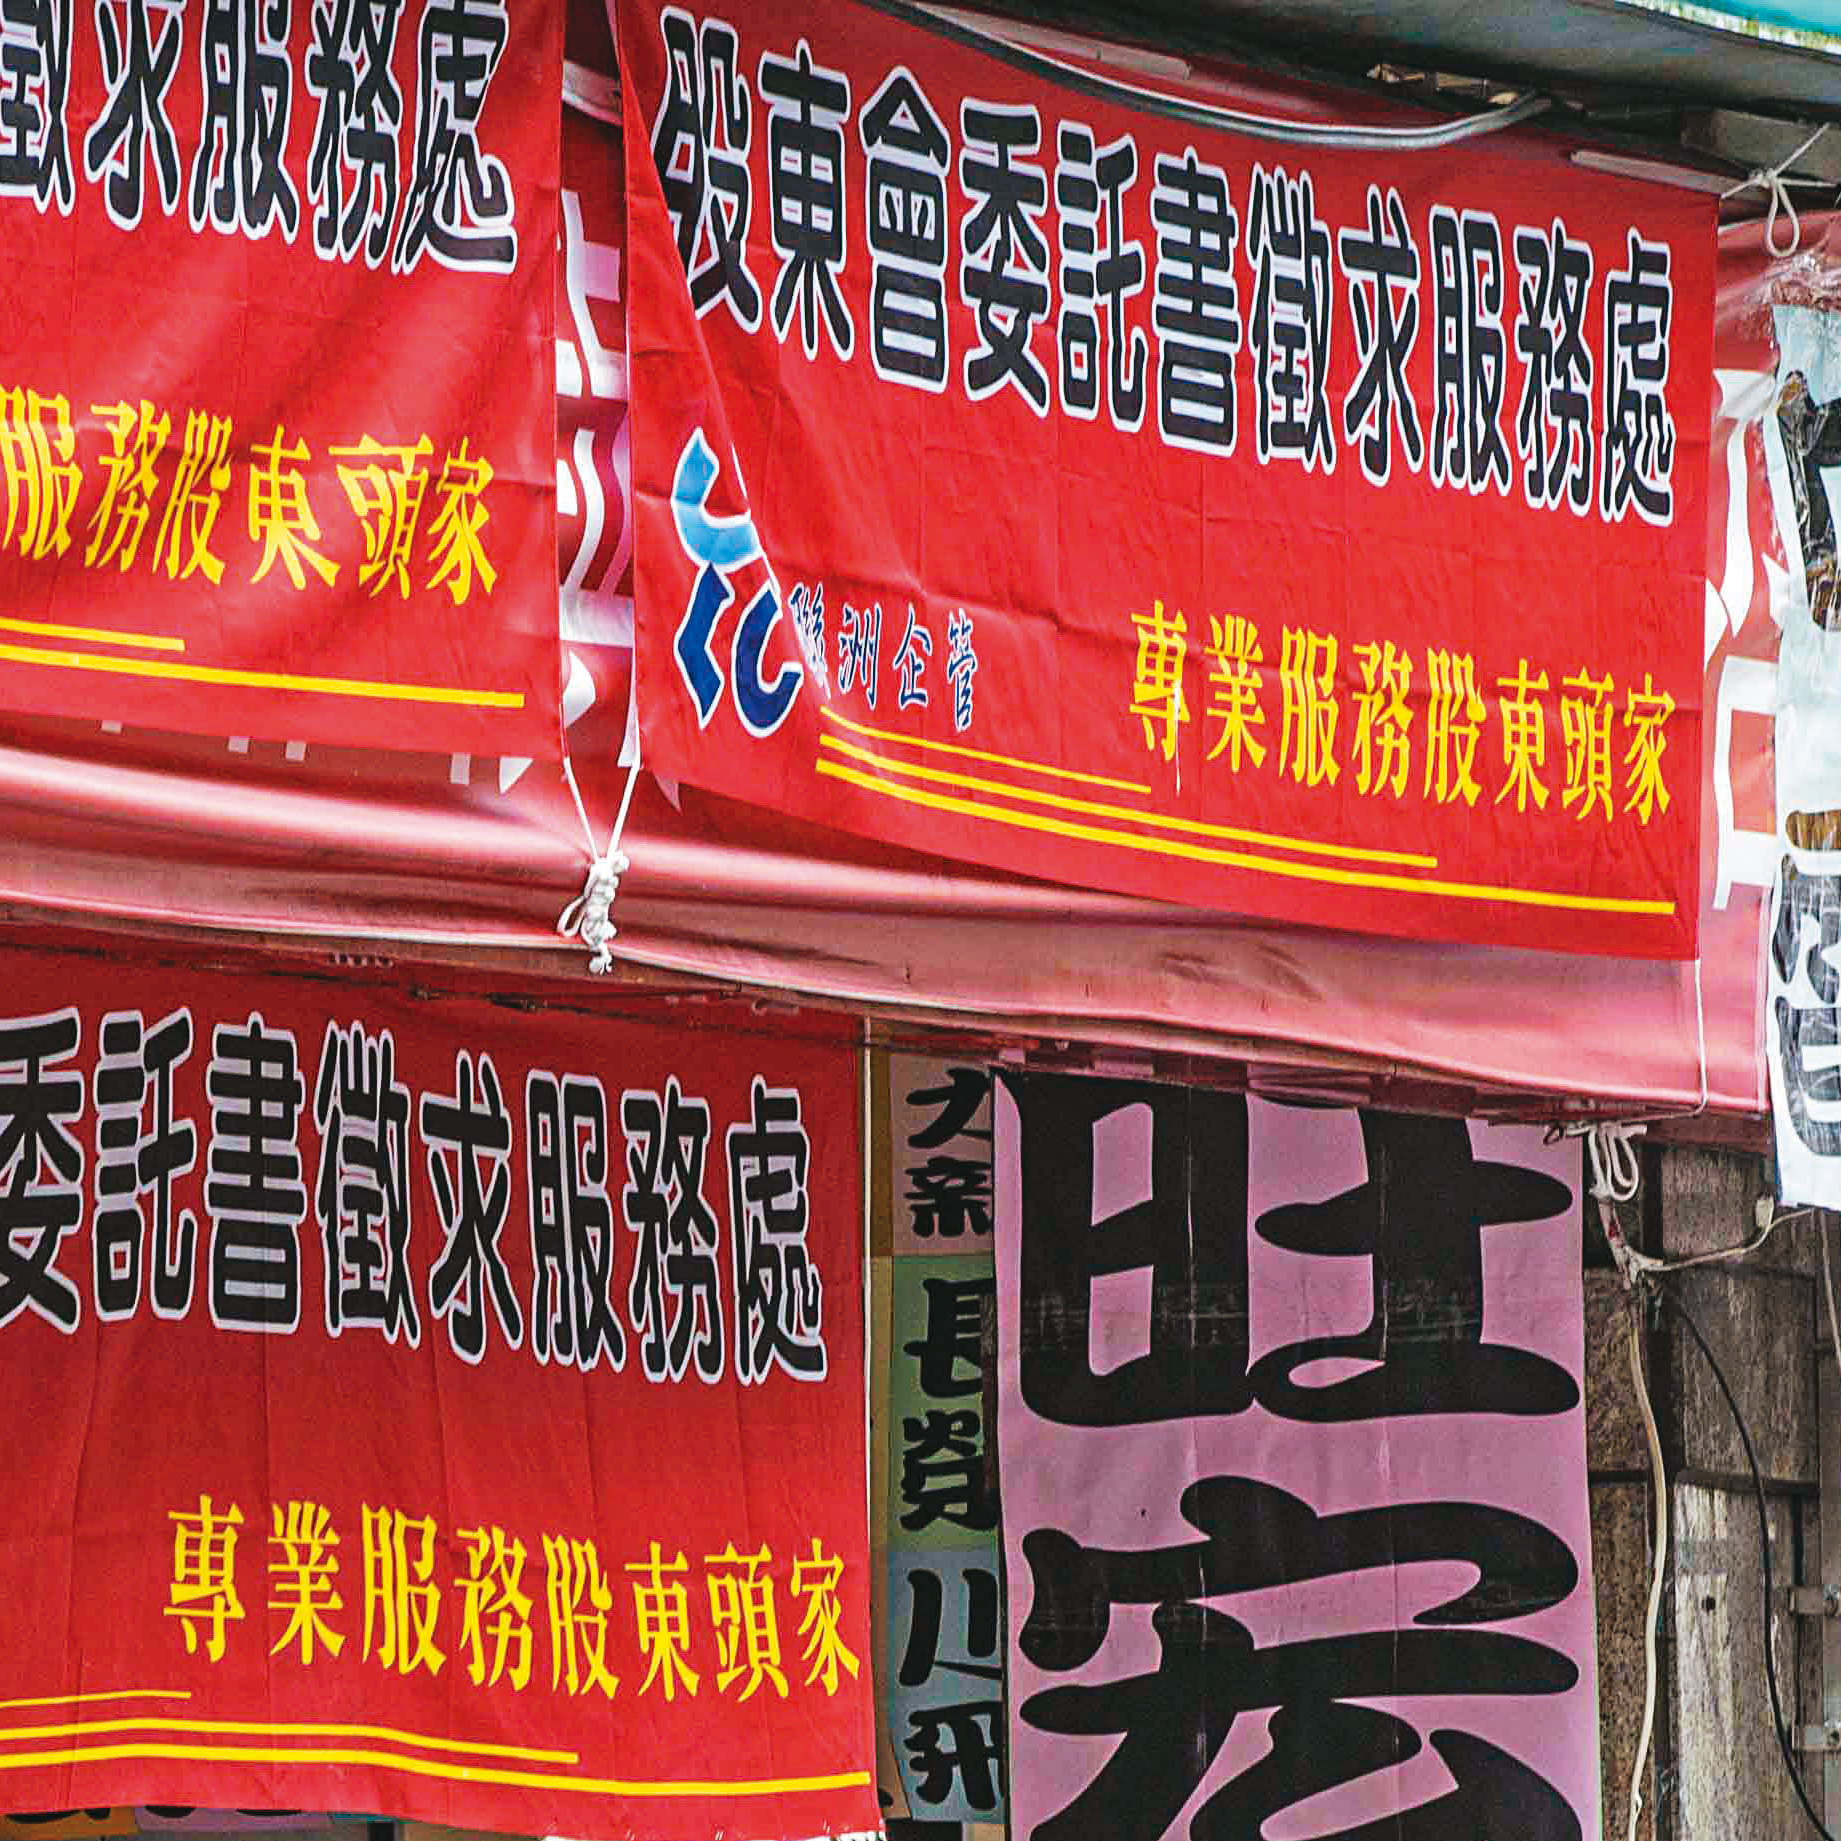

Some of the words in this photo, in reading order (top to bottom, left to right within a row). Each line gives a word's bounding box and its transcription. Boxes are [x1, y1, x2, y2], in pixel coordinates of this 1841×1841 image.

[650, 5, 1675, 527] 股東會委託書徵求服務處
[1128, 600, 1676, 827] 專業服務股東頭家
[164, 1494, 861, 1702] 專業服務股東頭家
